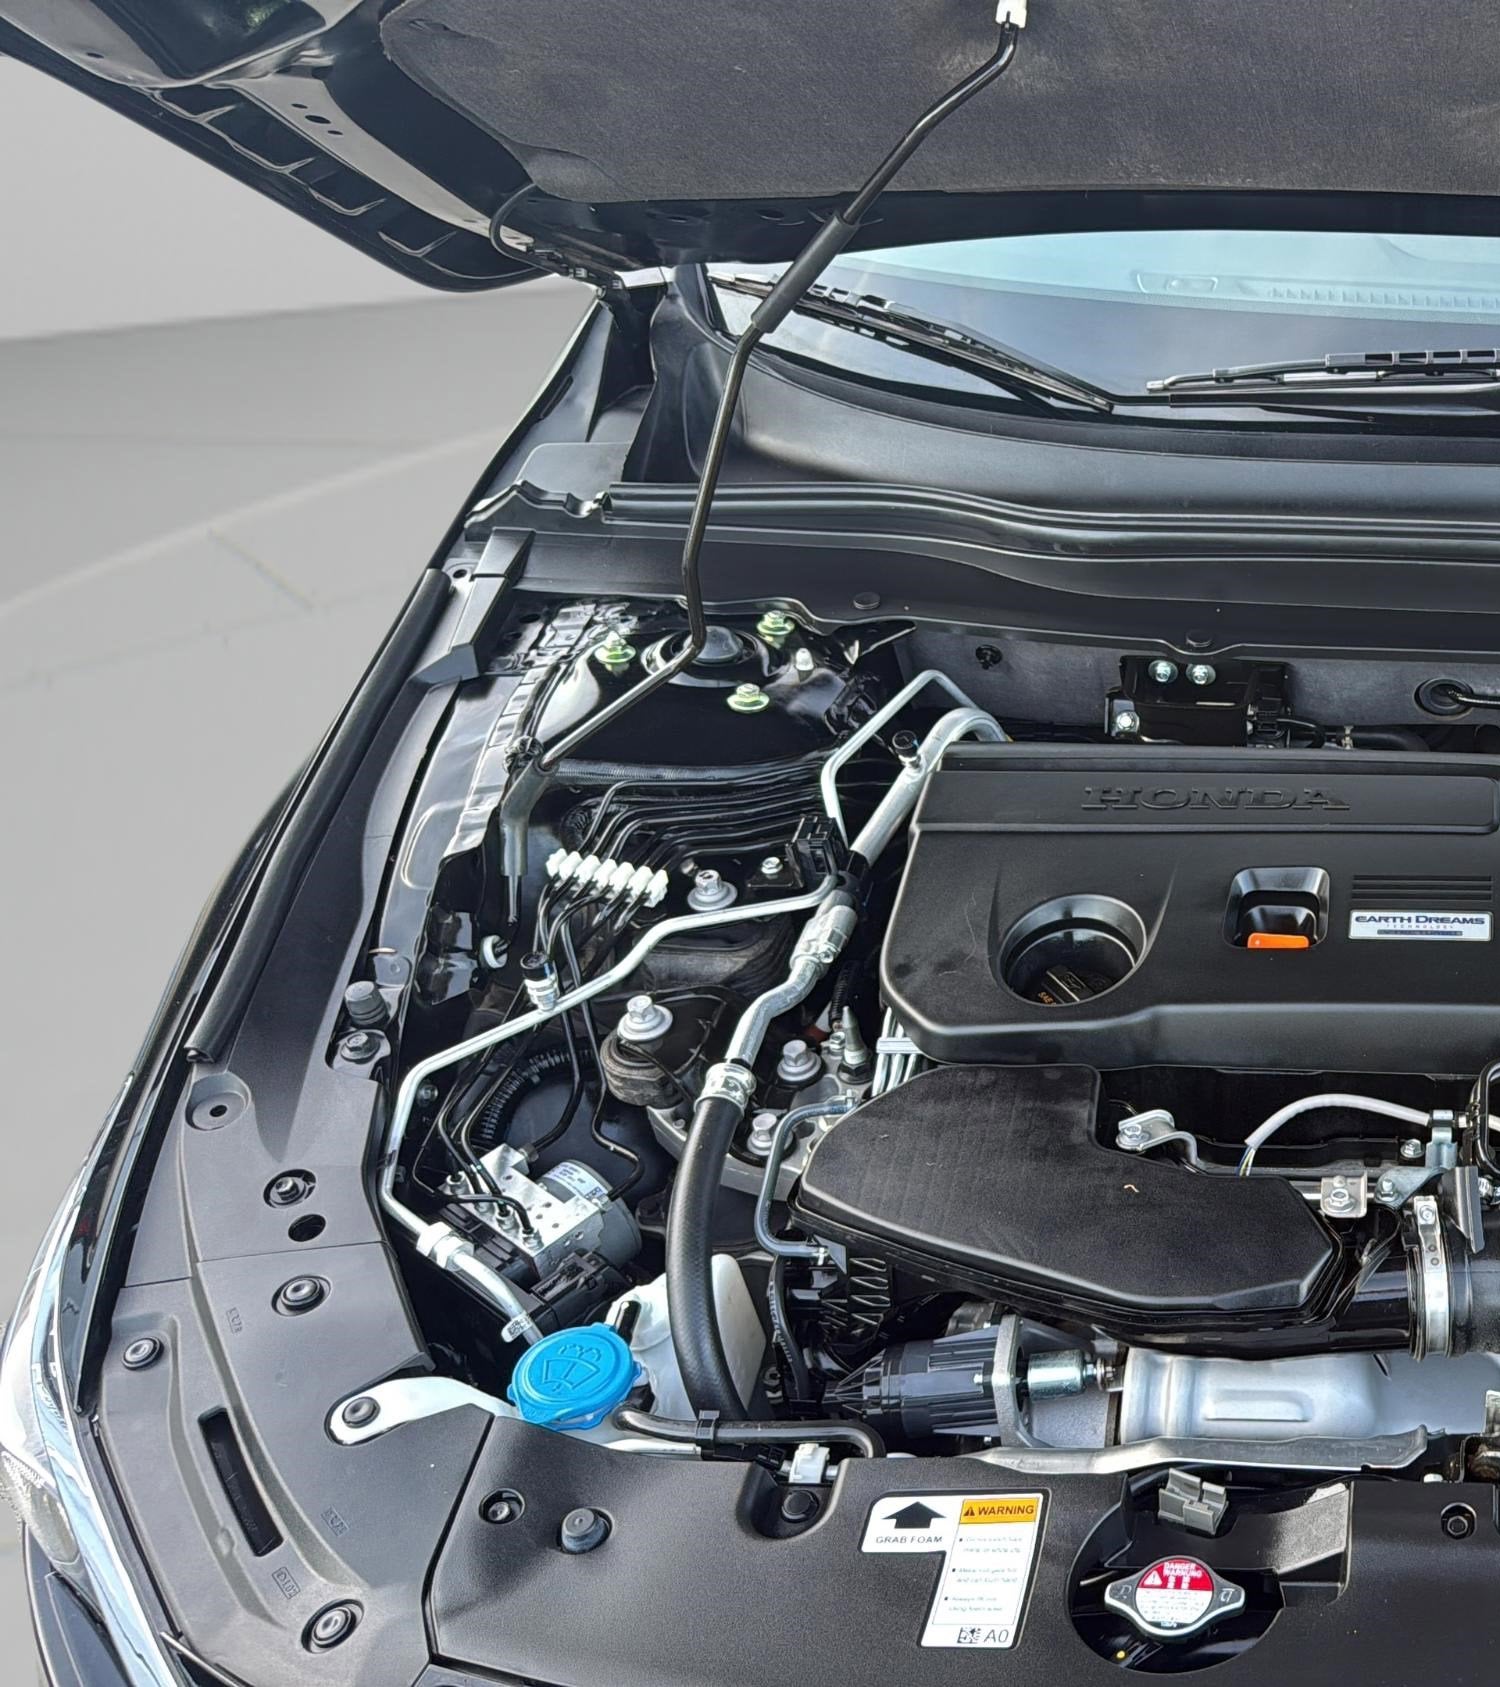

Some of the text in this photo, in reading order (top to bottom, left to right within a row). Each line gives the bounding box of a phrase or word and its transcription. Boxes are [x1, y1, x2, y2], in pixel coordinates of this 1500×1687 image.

[1081, 786, 1350, 811] HONDA
[1355, 915, 1485, 925] EARTH DREAMS
[978, 1504, 1034, 1516] WARNING
[876, 1536, 907, 1544] GRAB
[1163, 1562, 1196, 1570] DANGER
[983, 1629, 1009, 1643] A0
